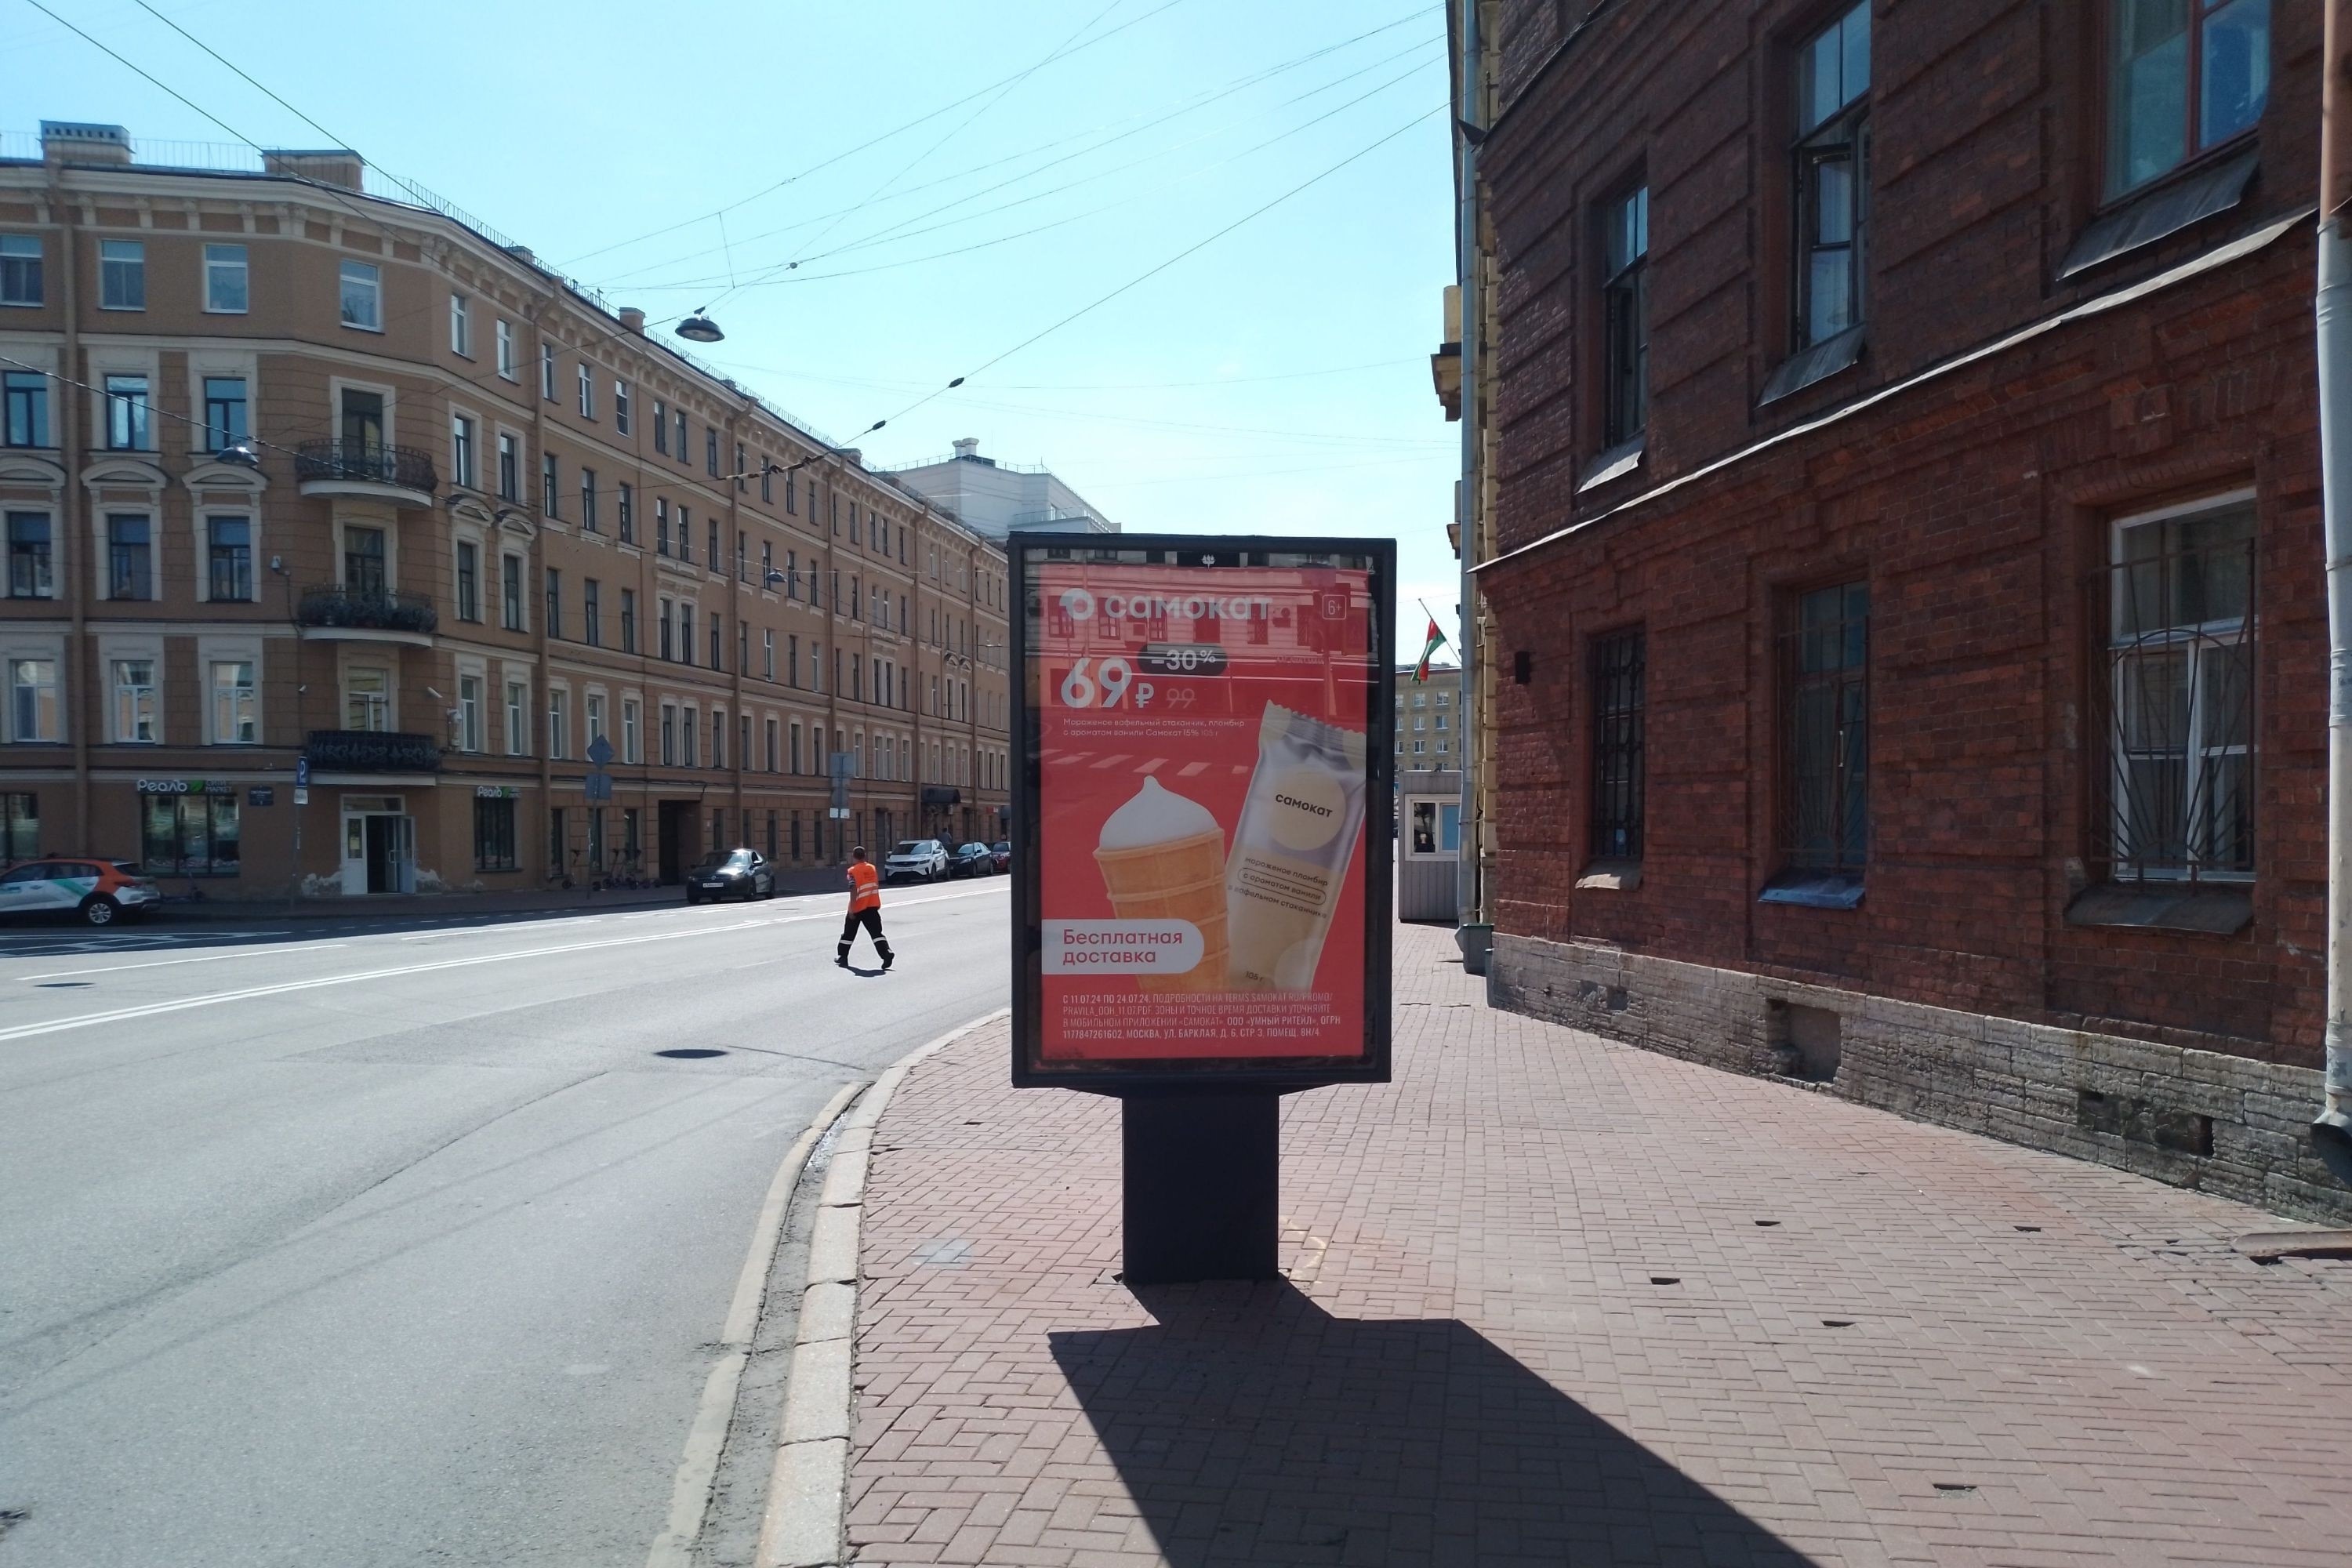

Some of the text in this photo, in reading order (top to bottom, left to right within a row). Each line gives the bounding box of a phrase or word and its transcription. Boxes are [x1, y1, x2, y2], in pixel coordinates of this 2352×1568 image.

[1105, 594, 1273, 620] самокат
[1327, 598, 1343, 616] 6+
[1151, 649, 1216, 671] -30%
[1061, 656, 1197, 709] 69 ₽ 99
[1063, 717, 1245, 728] Мороженое вафельный стаканчик, пломбир
[1070, 729, 1112, 738] ароматом
[137, 779, 187, 792] Реаль
[477, 786, 503, 797] Реаль
[1275, 793, 1334, 818] самокат
[1244, 856, 1328, 887] мороженое пломбир
[1250, 874, 1290, 892] ароматом
[1290, 887, 1322, 901] ванили
[1233, 887, 1279, 906] вафельном
[1063, 928, 1183, 945] Бесплатная
[1062, 951, 1156, 965] доставка
[1244, 970, 1259, 982] 105
[1062, 994, 1069, 1004] С
[1103, 994, 1115, 1004] ПО
[1152, 993, 1210, 1004] ПОДРОБНОСТИ
[1212, 993, 1223, 1003] НА
[1155, 1005, 1178, 1014] ЗОНЫ
[1179, 1005, 1185, 1014] И
[1187, 1004, 1217, 1014] ТОЧНОЕ
[1218, 1004, 1244, 1014] ВРЕМЯ
[1246, 1004, 1287, 1015] ДОСТАВКИ
[1288, 1003, 1331, 1014] УТОЧНЯЙТЕ
[1062, 1018, 1069, 1028] В
[1070, 1018, 1121, 1028] МОБИЛЬНОМ
[1123, 1017, 1178, 1027] ПРИЛОЖЕНИИ
[1227, 1016, 1243, 1026] ООО
[1246, 1014, 1279, 1027] «УМНЫЙ
[1320, 1015, 1341, 1025] ОГРН
[1127, 1029, 1162, 1040] МОСКВА,
[1163, 1029, 1177, 1040] УЛ.
[1267, 1028, 1299, 1039] ПОМЕЩ.
